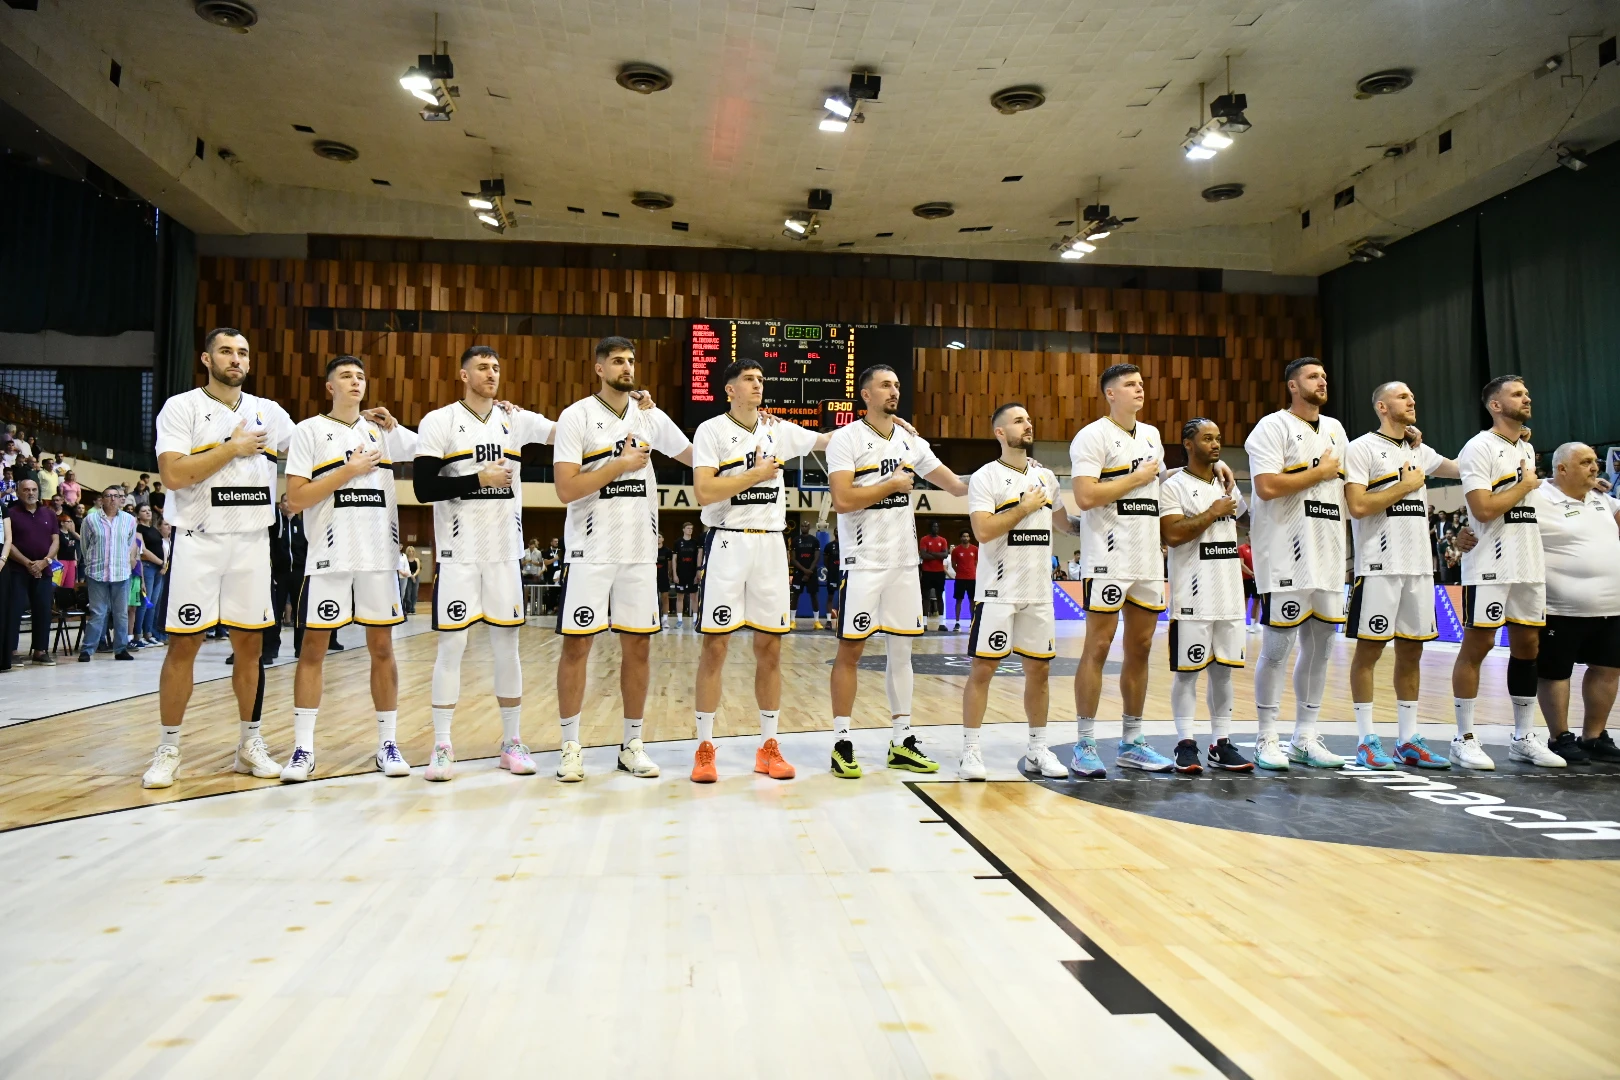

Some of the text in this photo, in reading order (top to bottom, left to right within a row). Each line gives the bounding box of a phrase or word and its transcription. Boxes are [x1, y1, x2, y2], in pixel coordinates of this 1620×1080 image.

[770, 326, 776, 336] 0
[788, 326, 820, 338] 03:00
[830, 328, 836, 337] 0
[780, 362, 786, 372] 0
[830, 364, 836, 374] 0
[828, 402, 852, 411] 03:00
[476, 444, 502, 462] BIH
[218, 491, 268, 500] telemach
